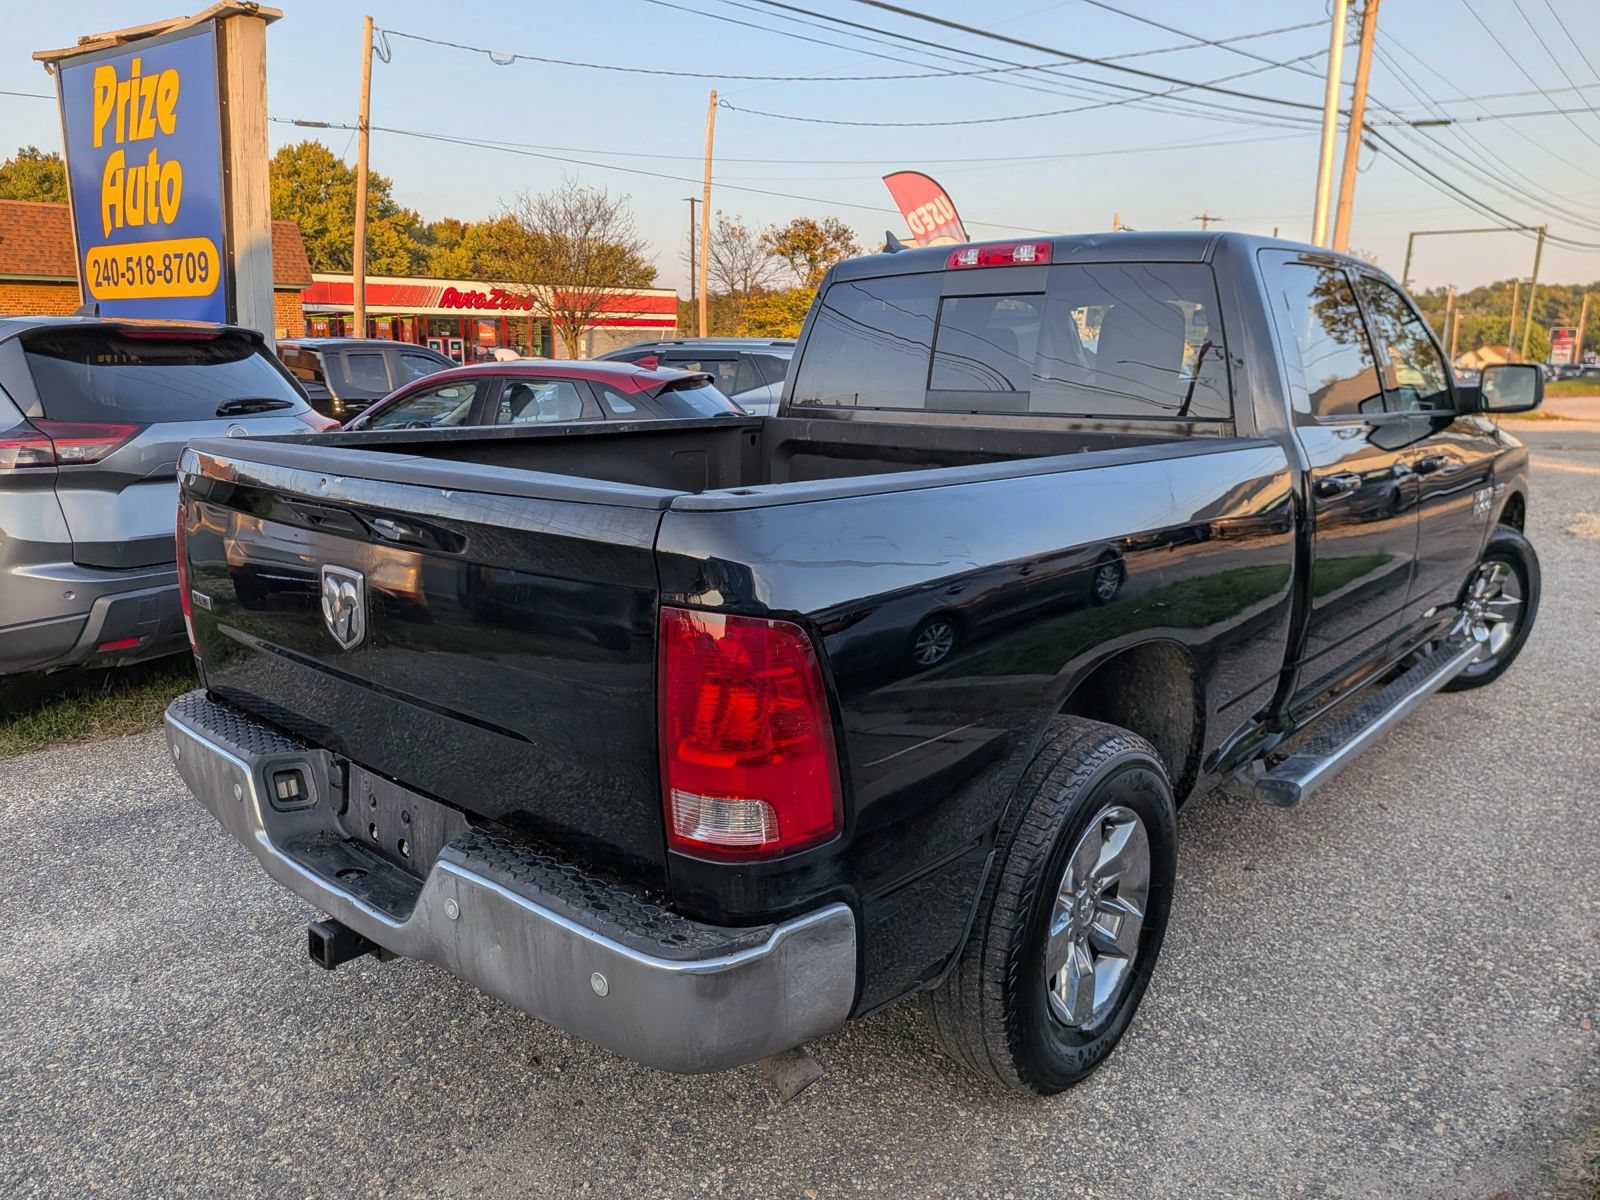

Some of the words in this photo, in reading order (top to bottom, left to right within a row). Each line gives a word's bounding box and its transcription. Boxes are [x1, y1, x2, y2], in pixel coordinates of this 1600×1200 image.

[93, 57, 180, 148] Prize
[102, 148, 184, 239] Auto
[92, 251, 209, 288] 240-518-8709
[438, 287, 536, 311] AutoZone
